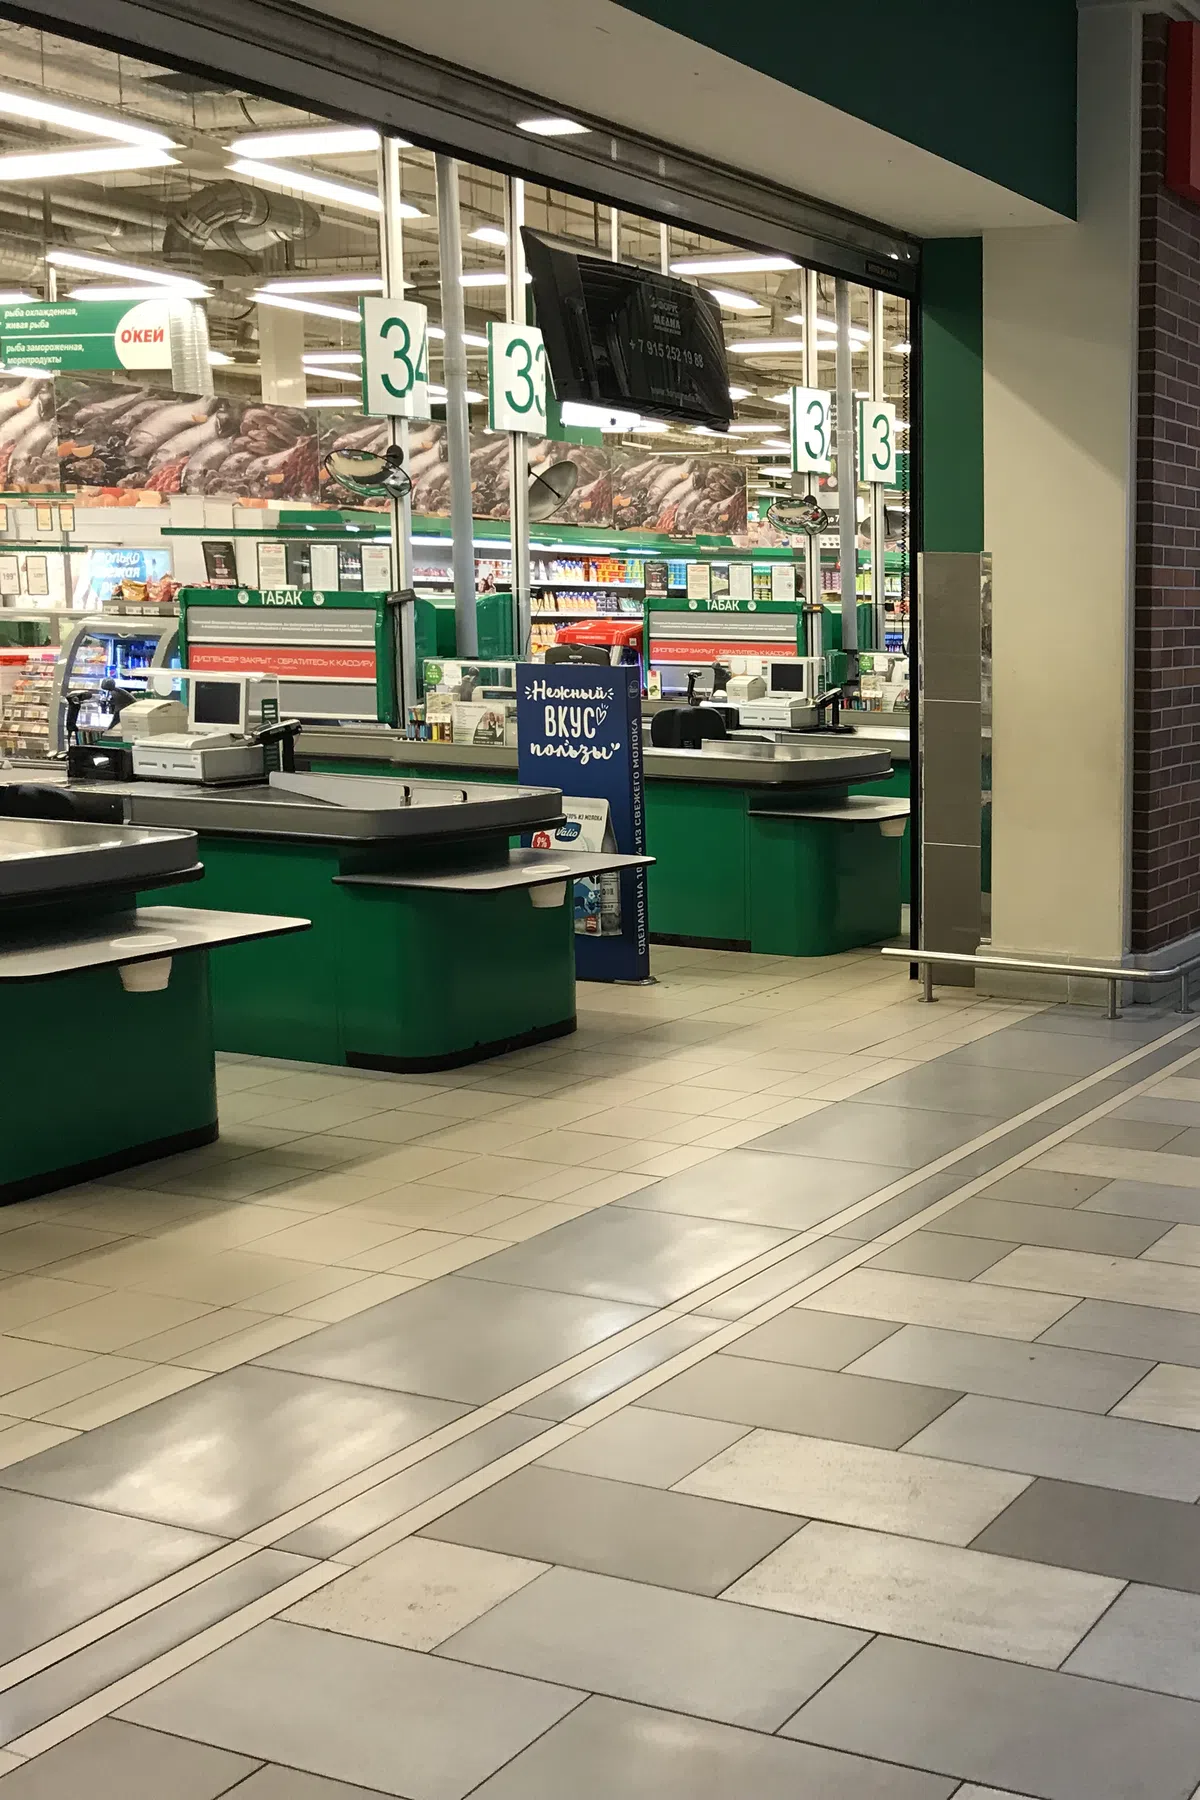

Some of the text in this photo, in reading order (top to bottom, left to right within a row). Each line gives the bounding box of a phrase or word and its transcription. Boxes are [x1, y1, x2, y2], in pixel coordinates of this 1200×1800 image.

[4, 307, 78, 318] рыба охлажденная,
[5, 319, 49, 330] живая рыба
[6, 343, 84, 354] рыба замороженная,
[646, 340, 664, 358] 915
[665, 344, 681, 362] 252
[7, 355, 62, 365] морепродукты
[259, 590, 303, 605] ТАБАК
[705, 600, 740, 611] ТАБАК
[193, 655, 240, 664] ДИСПЕНСЕР
[278, 657, 328, 666] ОБРАТИТЕСЬ
[336, 659, 374, 668] КАССИРУ
[532, 680, 608, 701] Нежный
[544, 705, 596, 739] ВКУС
[631, 718, 640, 768] МОЛОКА
[530, 741, 613, 765] пользы
[632, 771, 642, 826] СВЕЖЕГО
[556, 827, 578, 838] Valio
[634, 830, 642, 845] ИЗ
[635, 882, 644, 899] НА
[637, 901, 646, 955] СДЕЛАНО
